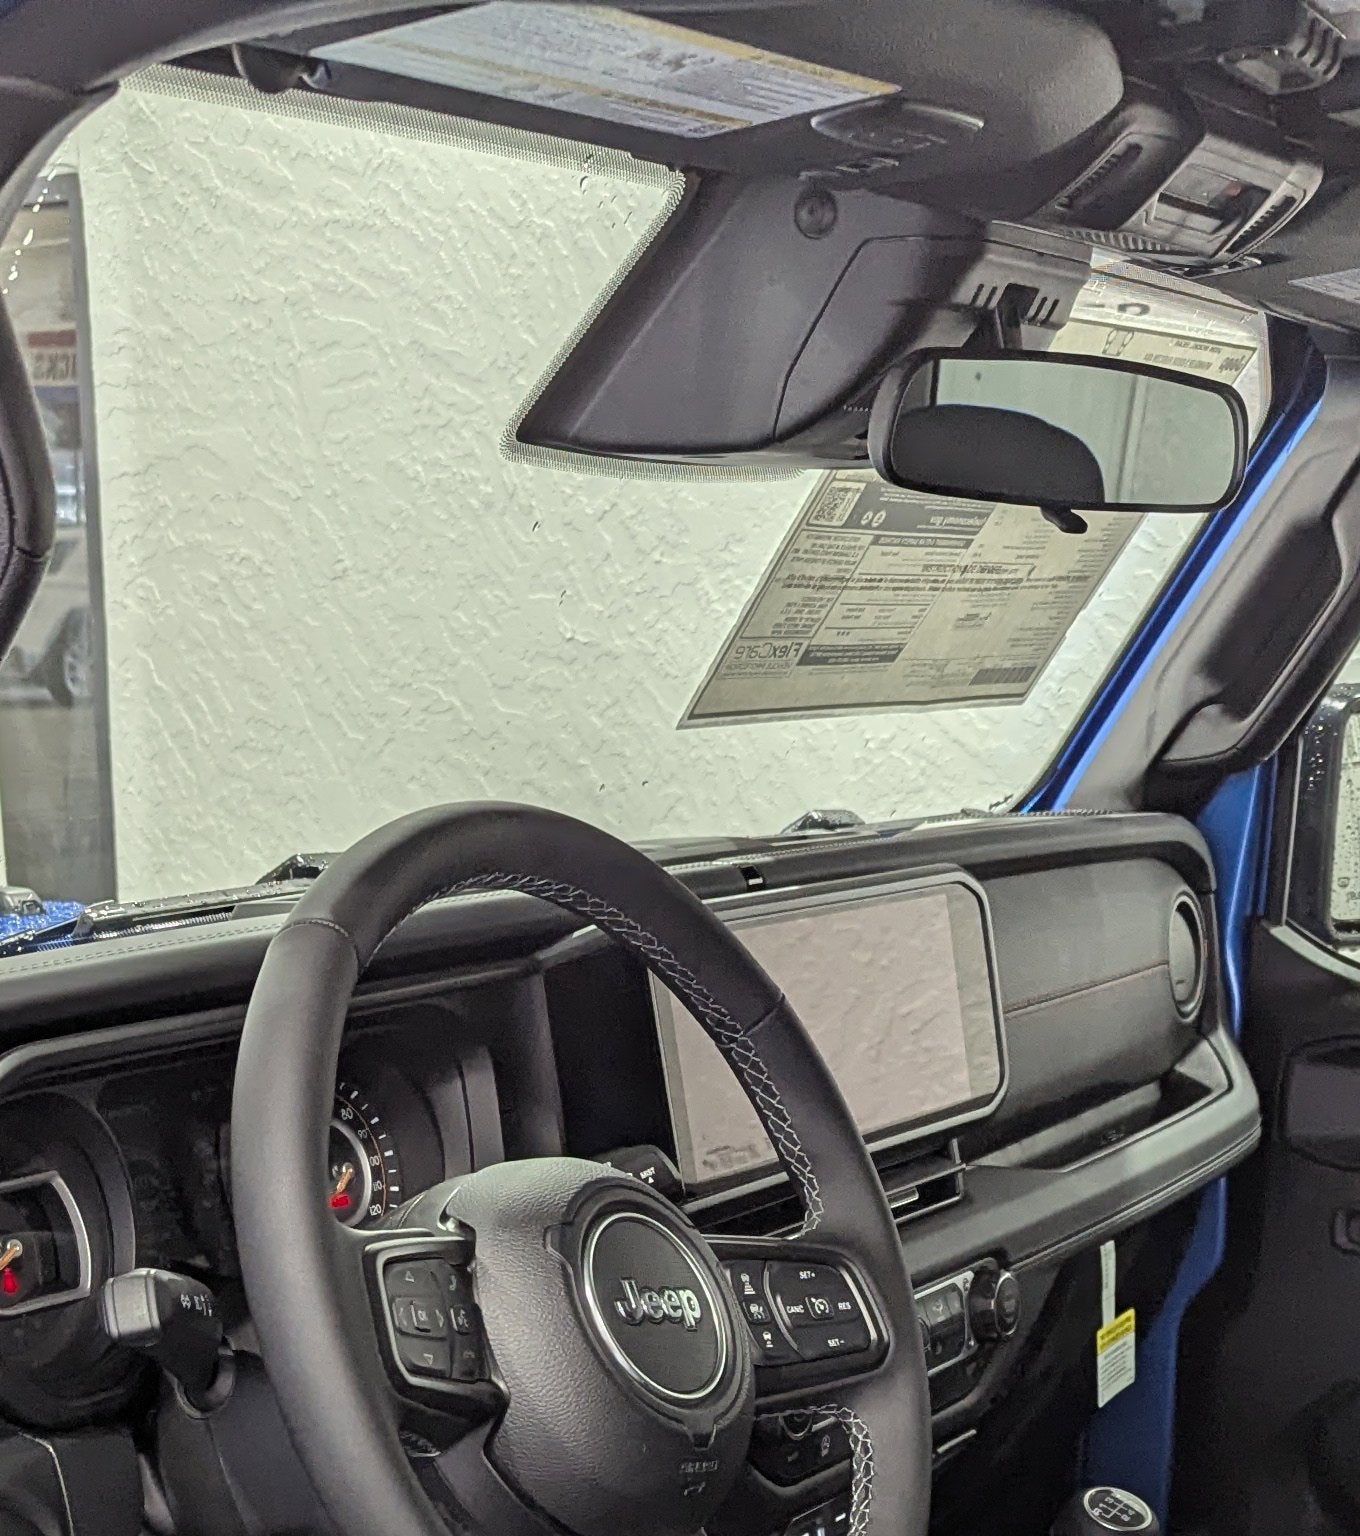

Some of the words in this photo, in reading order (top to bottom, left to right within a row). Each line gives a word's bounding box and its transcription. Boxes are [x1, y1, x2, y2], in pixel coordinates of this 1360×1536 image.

[341, 1107, 354, 1121] 80
[357, 1129, 368, 1140] 90
[369, 1155, 381, 1167] 00
[369, 1203, 382, 1216] 120
[613, 1278, 702, 1331] Jeep
